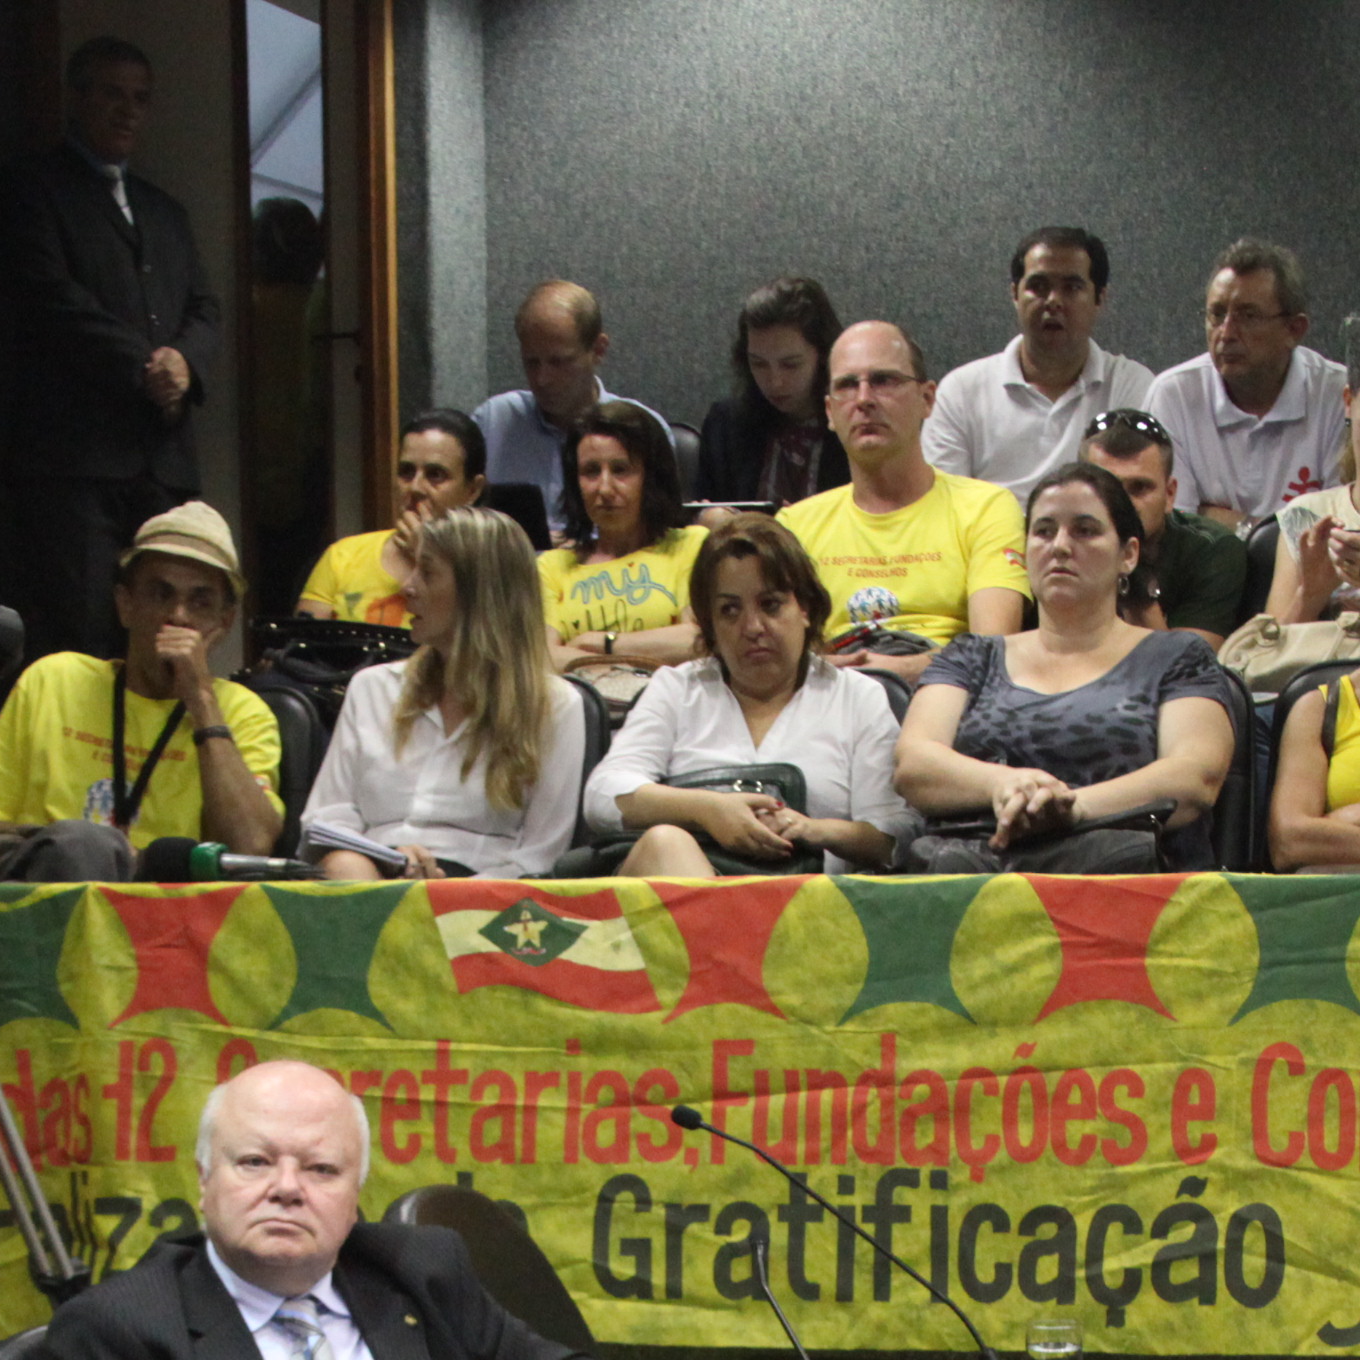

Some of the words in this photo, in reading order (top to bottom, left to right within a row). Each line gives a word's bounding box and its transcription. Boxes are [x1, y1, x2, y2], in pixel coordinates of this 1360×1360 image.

[570, 563, 677, 605] my
[102, 1038, 177, 1163] 12
[710, 1033, 1148, 1184] Fundações
[1170, 1067, 1218, 1166] e
[592, 1167, 1286, 1328] Gratificação
